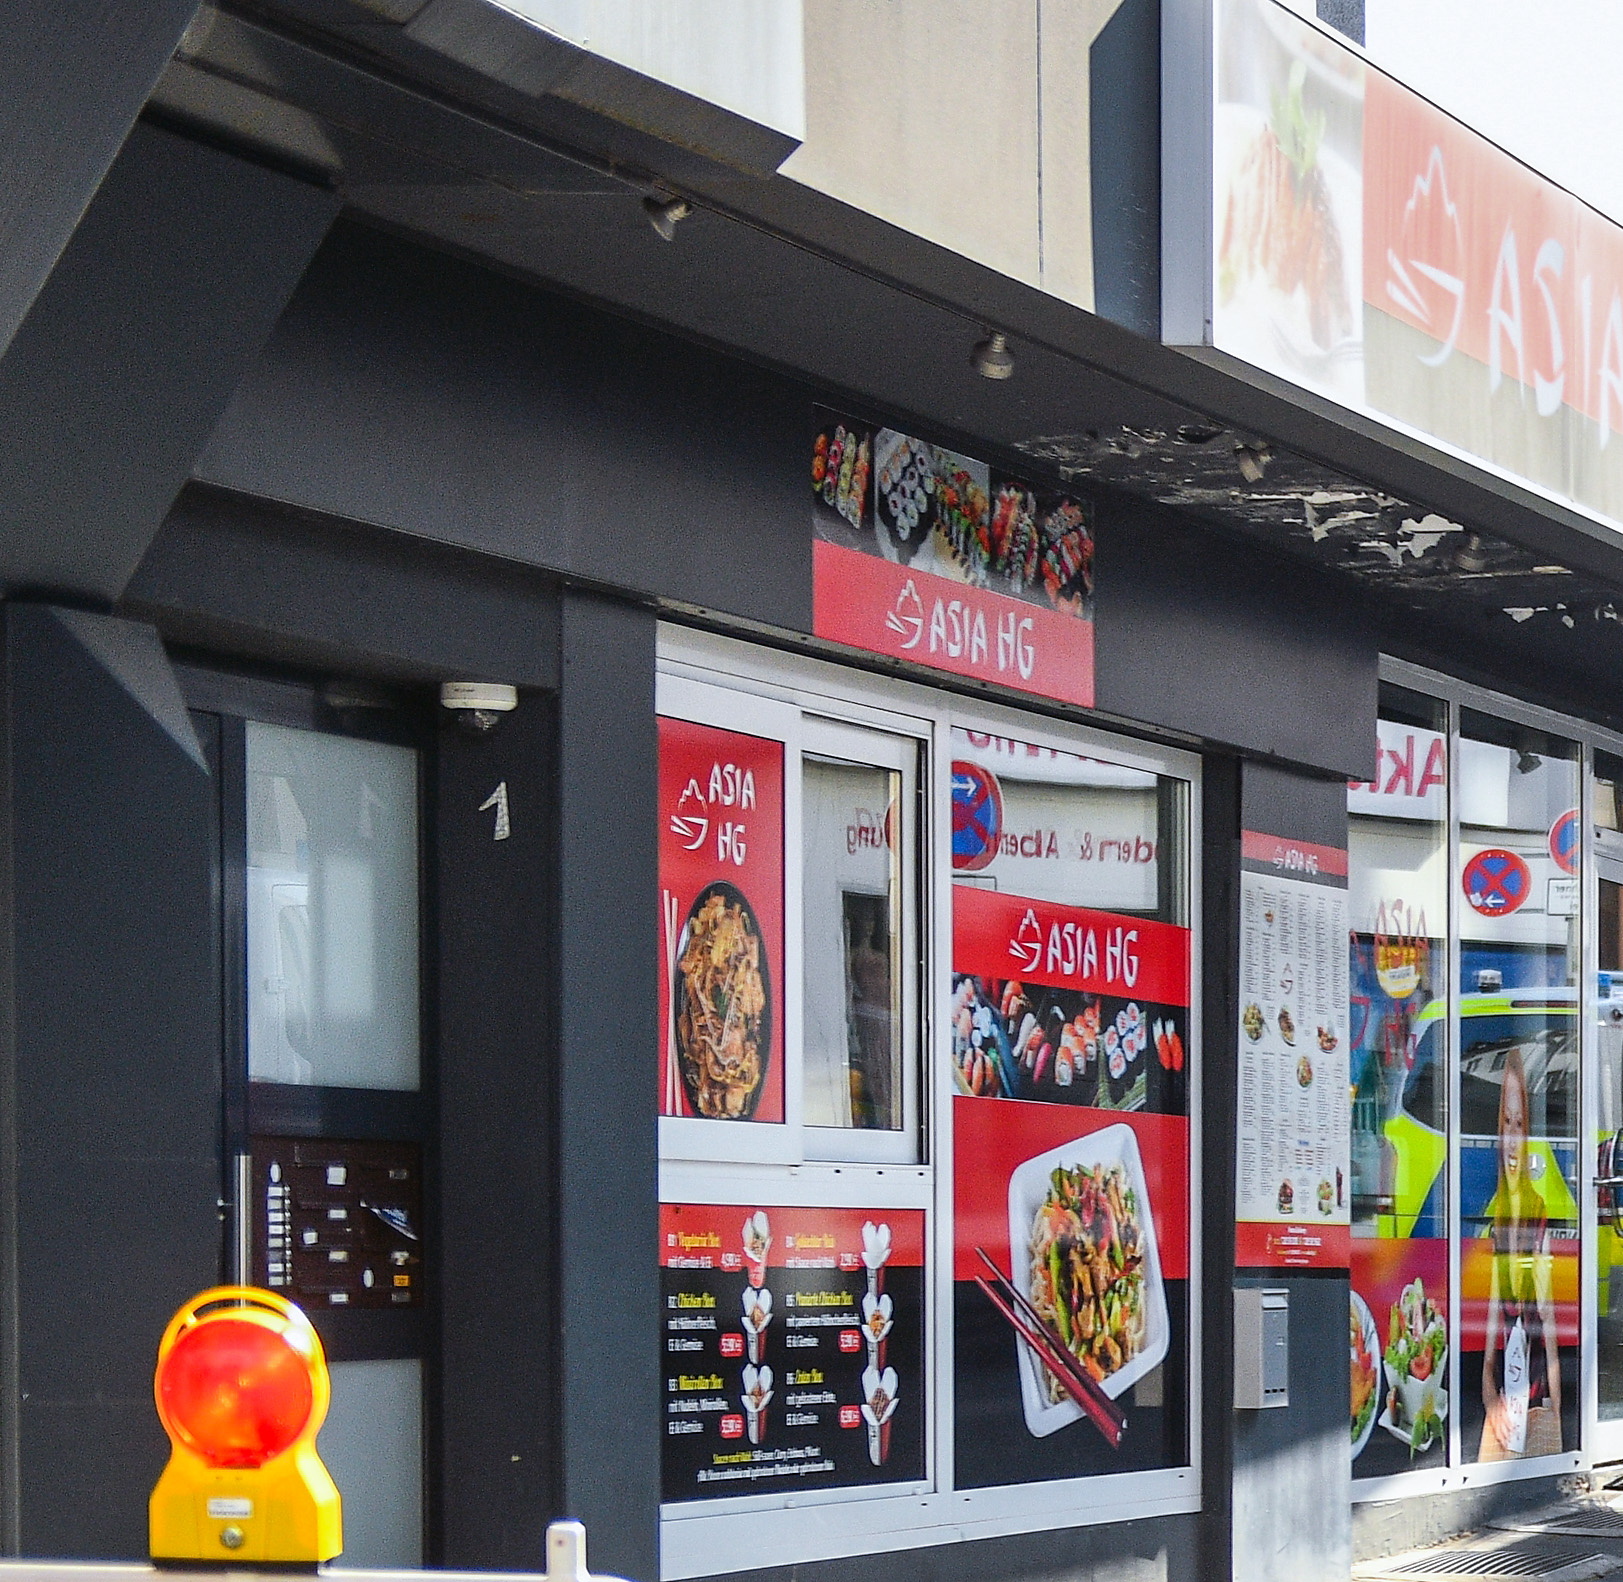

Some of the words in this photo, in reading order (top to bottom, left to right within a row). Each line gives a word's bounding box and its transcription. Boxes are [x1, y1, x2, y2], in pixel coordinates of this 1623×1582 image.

[929, 600, 988, 667] ASIA
[998, 612, 1036, 681] HG
[477, 780, 511, 841] 1
[708, 758, 756, 813] ASIA
[717, 821, 748, 866] HG
[1047, 924, 1098, 981] ASIA
[1105, 929, 1140, 988] HG
